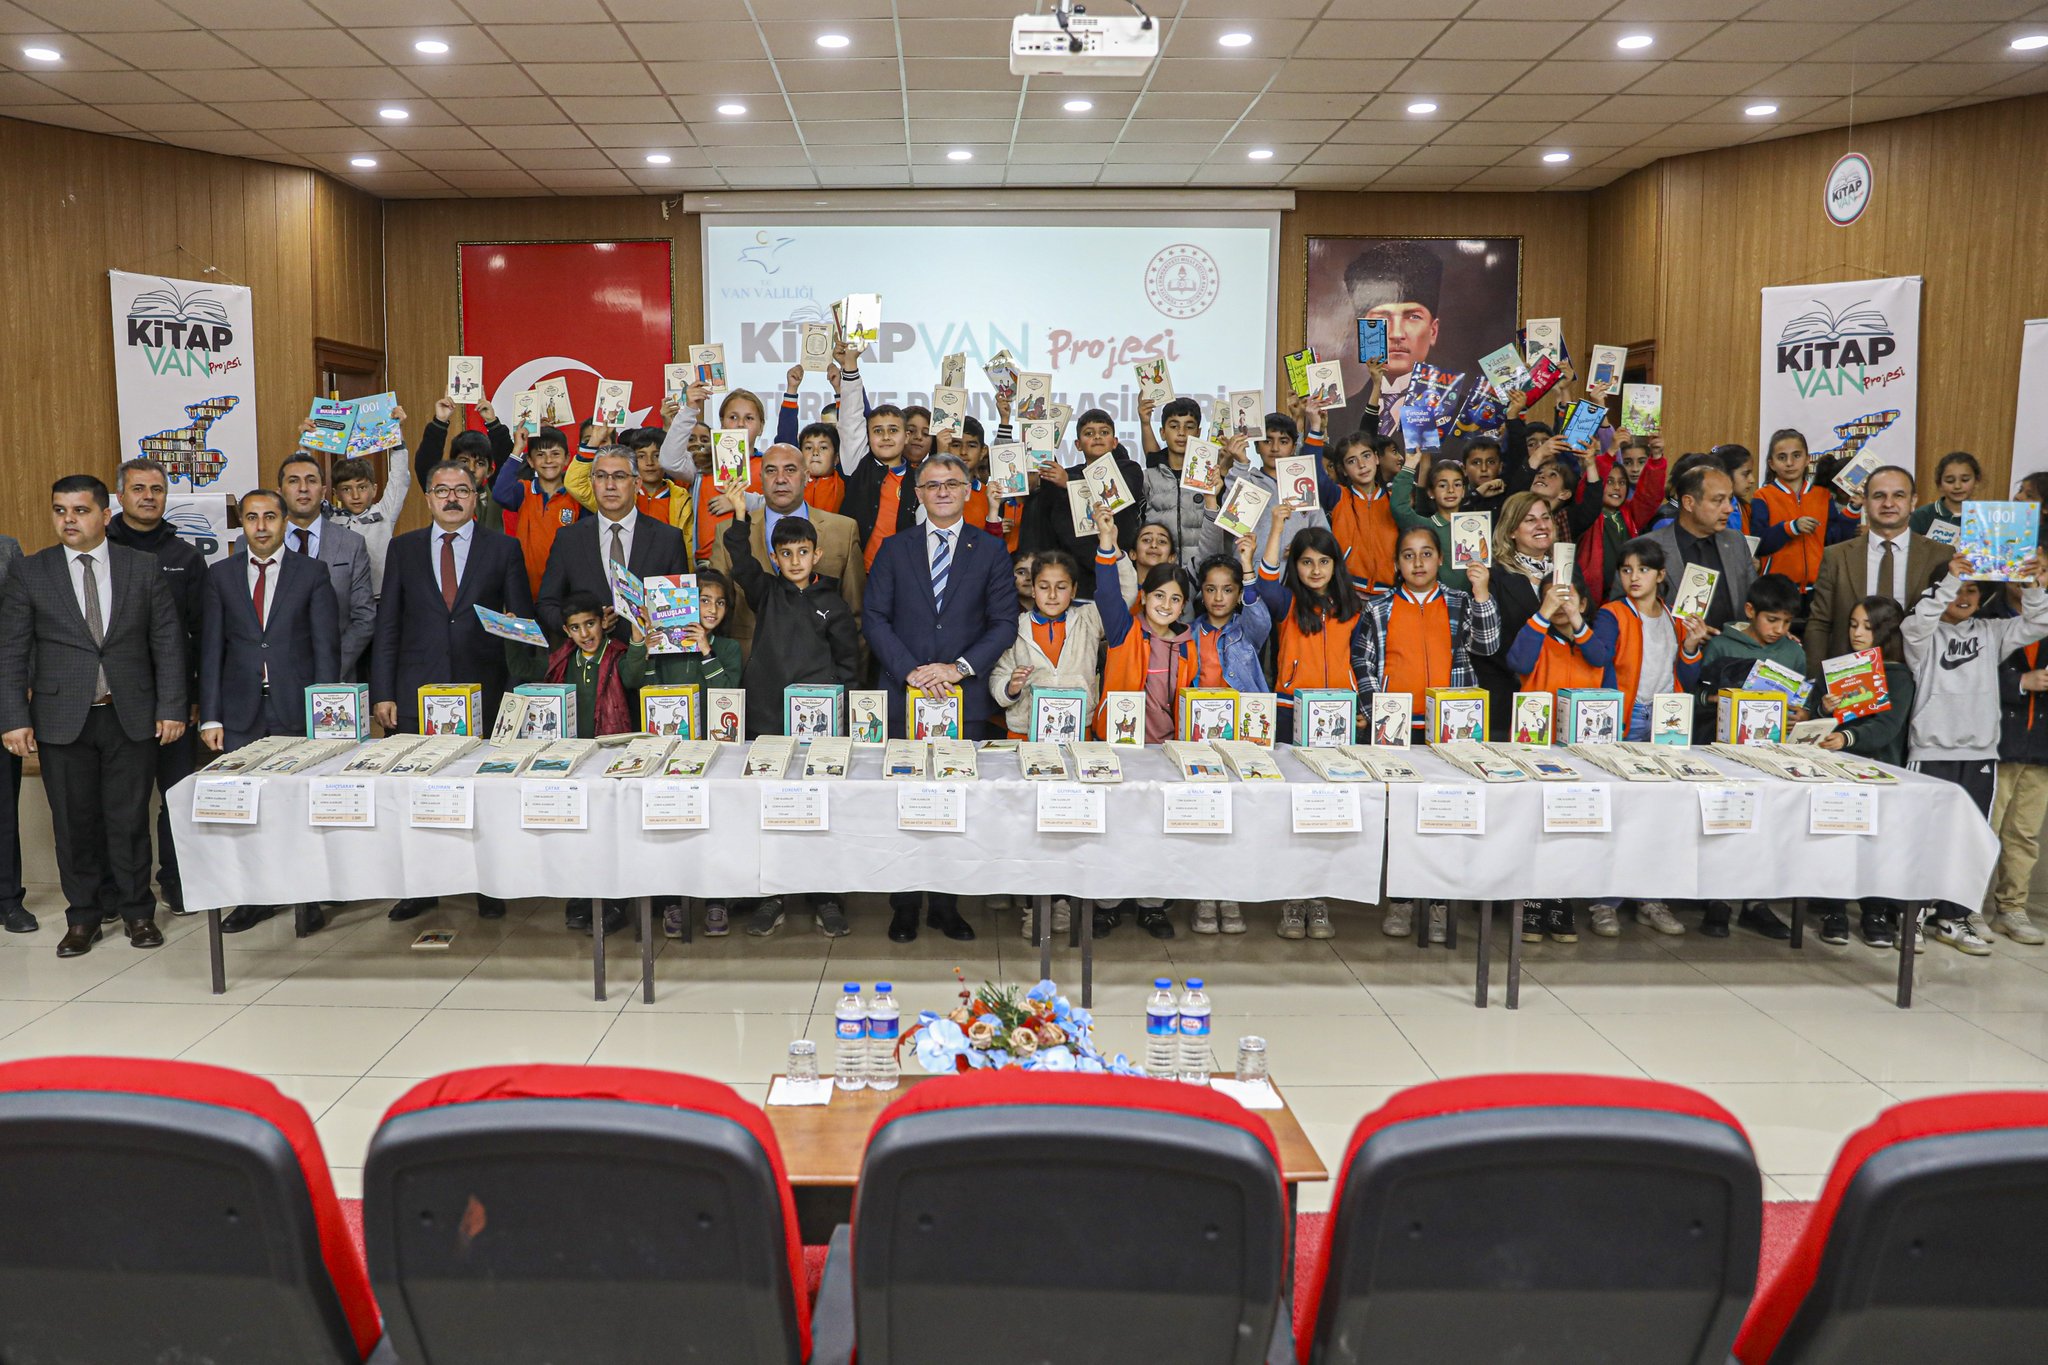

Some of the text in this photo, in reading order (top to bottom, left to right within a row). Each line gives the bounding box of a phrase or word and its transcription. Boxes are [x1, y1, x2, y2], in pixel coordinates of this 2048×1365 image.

[721, 286, 814, 300] VAN VALİLİĞİ
[741, 320, 916, 363] KiP
[917, 322, 1029, 371] VAN
[1047, 328, 1180, 379] Projesi
[143, 344, 211, 379] VAN
[208, 357, 242, 375] Projesi
[1791, 363, 1866, 399] VAN
[1862, 366, 1906, 389] Projesi
[1988, 510, 2015, 524] 1001
[657, 608, 687, 619] BULUŞLAR
[1948, 637, 1978, 656] NIKE
